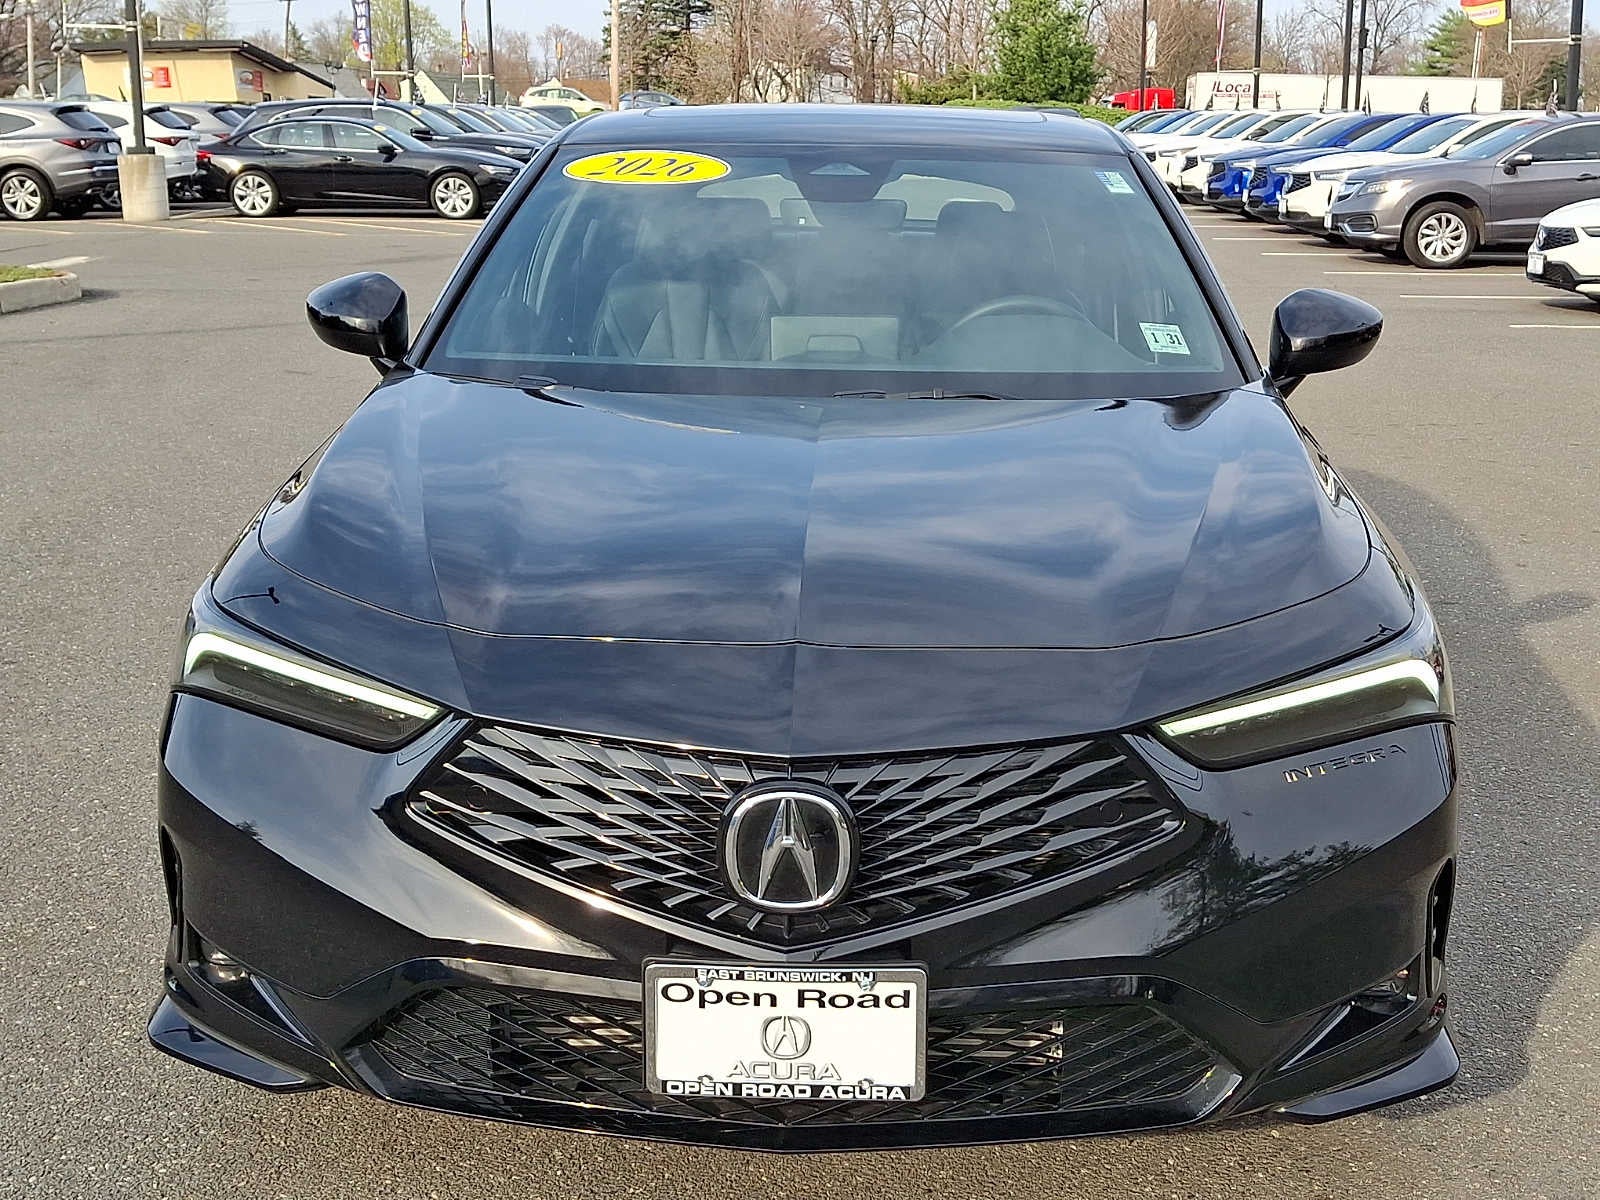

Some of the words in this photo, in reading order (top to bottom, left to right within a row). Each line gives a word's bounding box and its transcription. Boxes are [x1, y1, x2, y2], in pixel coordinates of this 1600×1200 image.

[586, 157, 705, 177] 2026
[1151, 332, 1160, 343] 1
[1166, 333, 1183, 345] 31
[1283, 744, 1407, 783] INTEGRA
[697, 968, 740, 980] EAST
[744, 970, 846, 982] BRUNSWICK,
[661, 983, 777, 1009] Open
[798, 989, 910, 1009] Road
[727, 1060, 842, 1081] ACURA
[666, 1080, 733, 1096] OPEN
[741, 1084, 811, 1098] ROAD
[821, 1086, 907, 1100] ACURA
